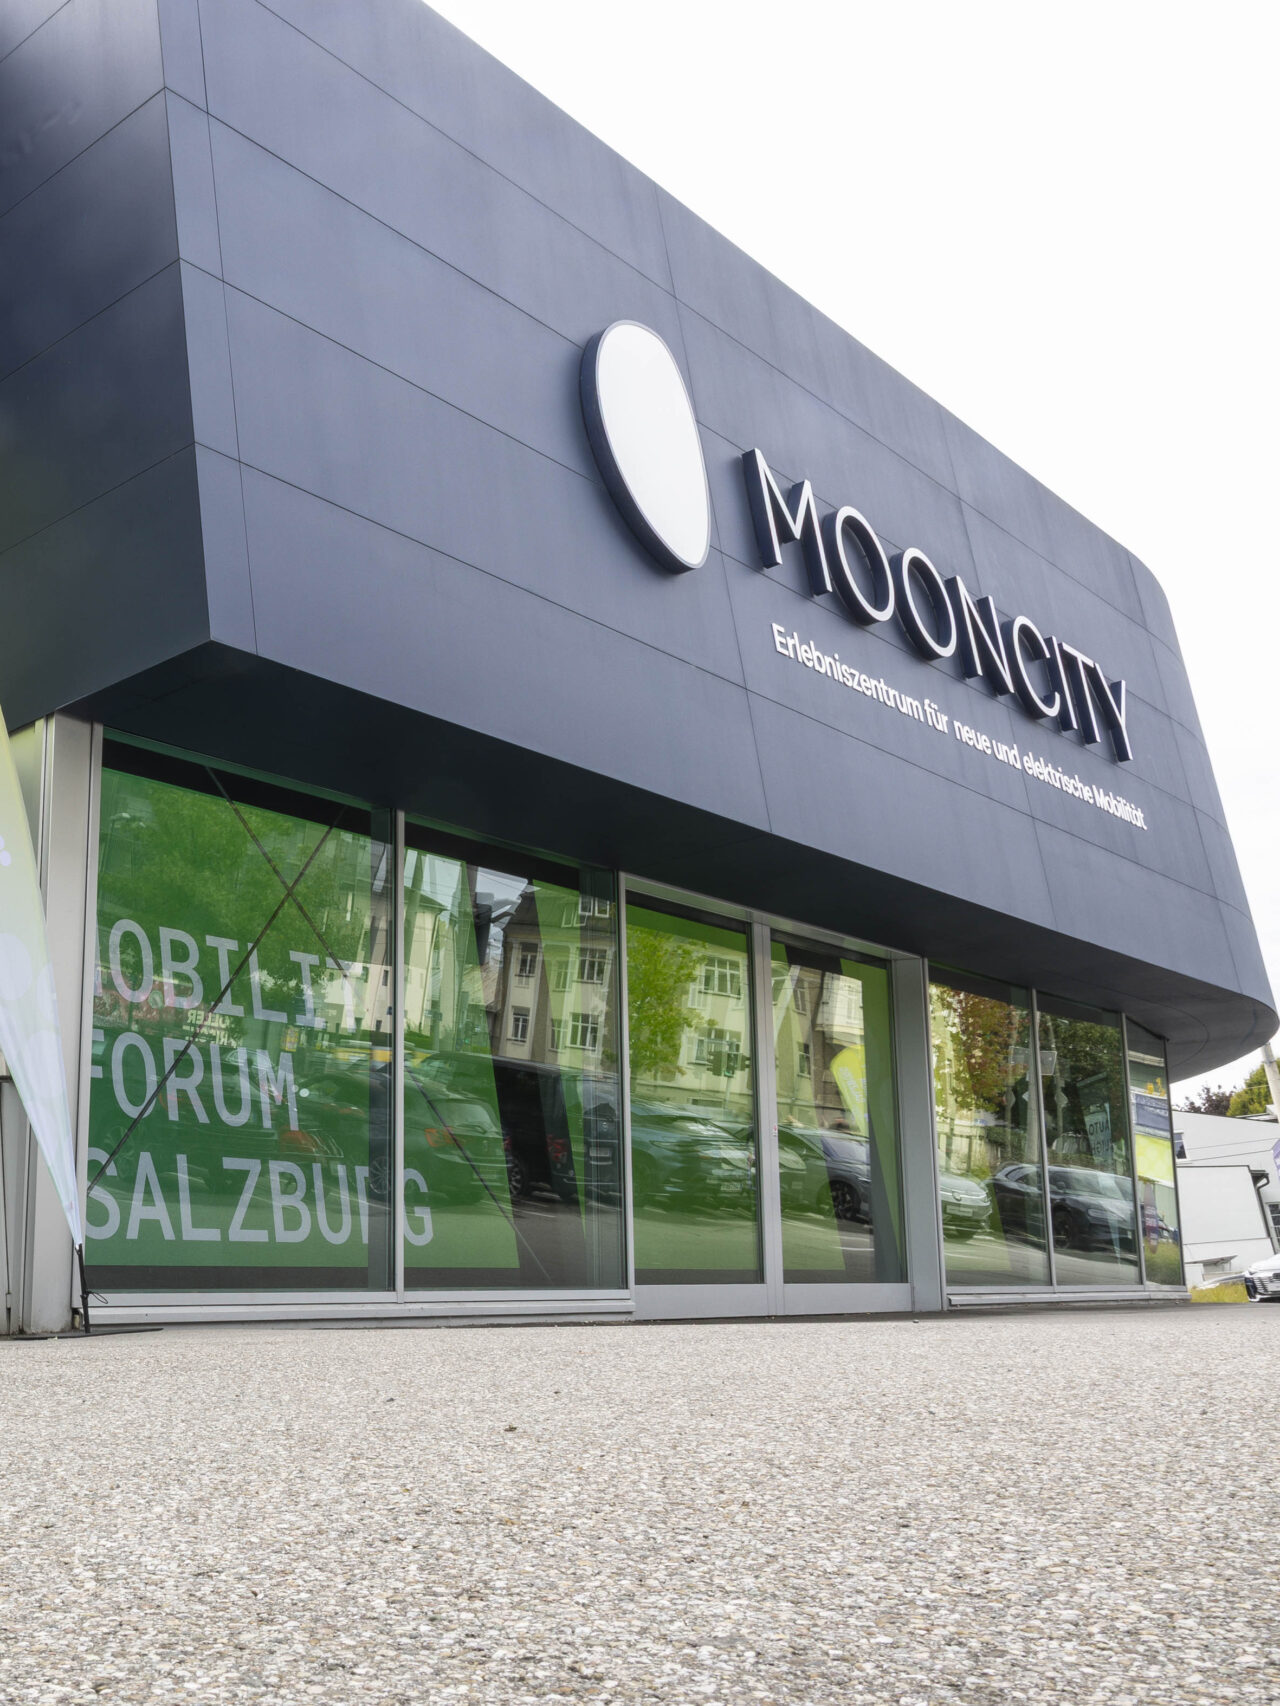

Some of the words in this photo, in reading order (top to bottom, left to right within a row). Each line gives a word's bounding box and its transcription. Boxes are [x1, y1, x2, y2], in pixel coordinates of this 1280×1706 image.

[740, 447, 1134, 764] MOONCITY
[771, 622, 923, 722] Erlebniszentrum
[924, 698, 949, 735] für
[953, 719, 992, 755] neue
[992, 739, 1022, 770] und
[1023, 751, 1094, 805] elektrische
[1093, 784, 1148, 831] Mobilität
[94, 918, 365, 1034] OBILIT
